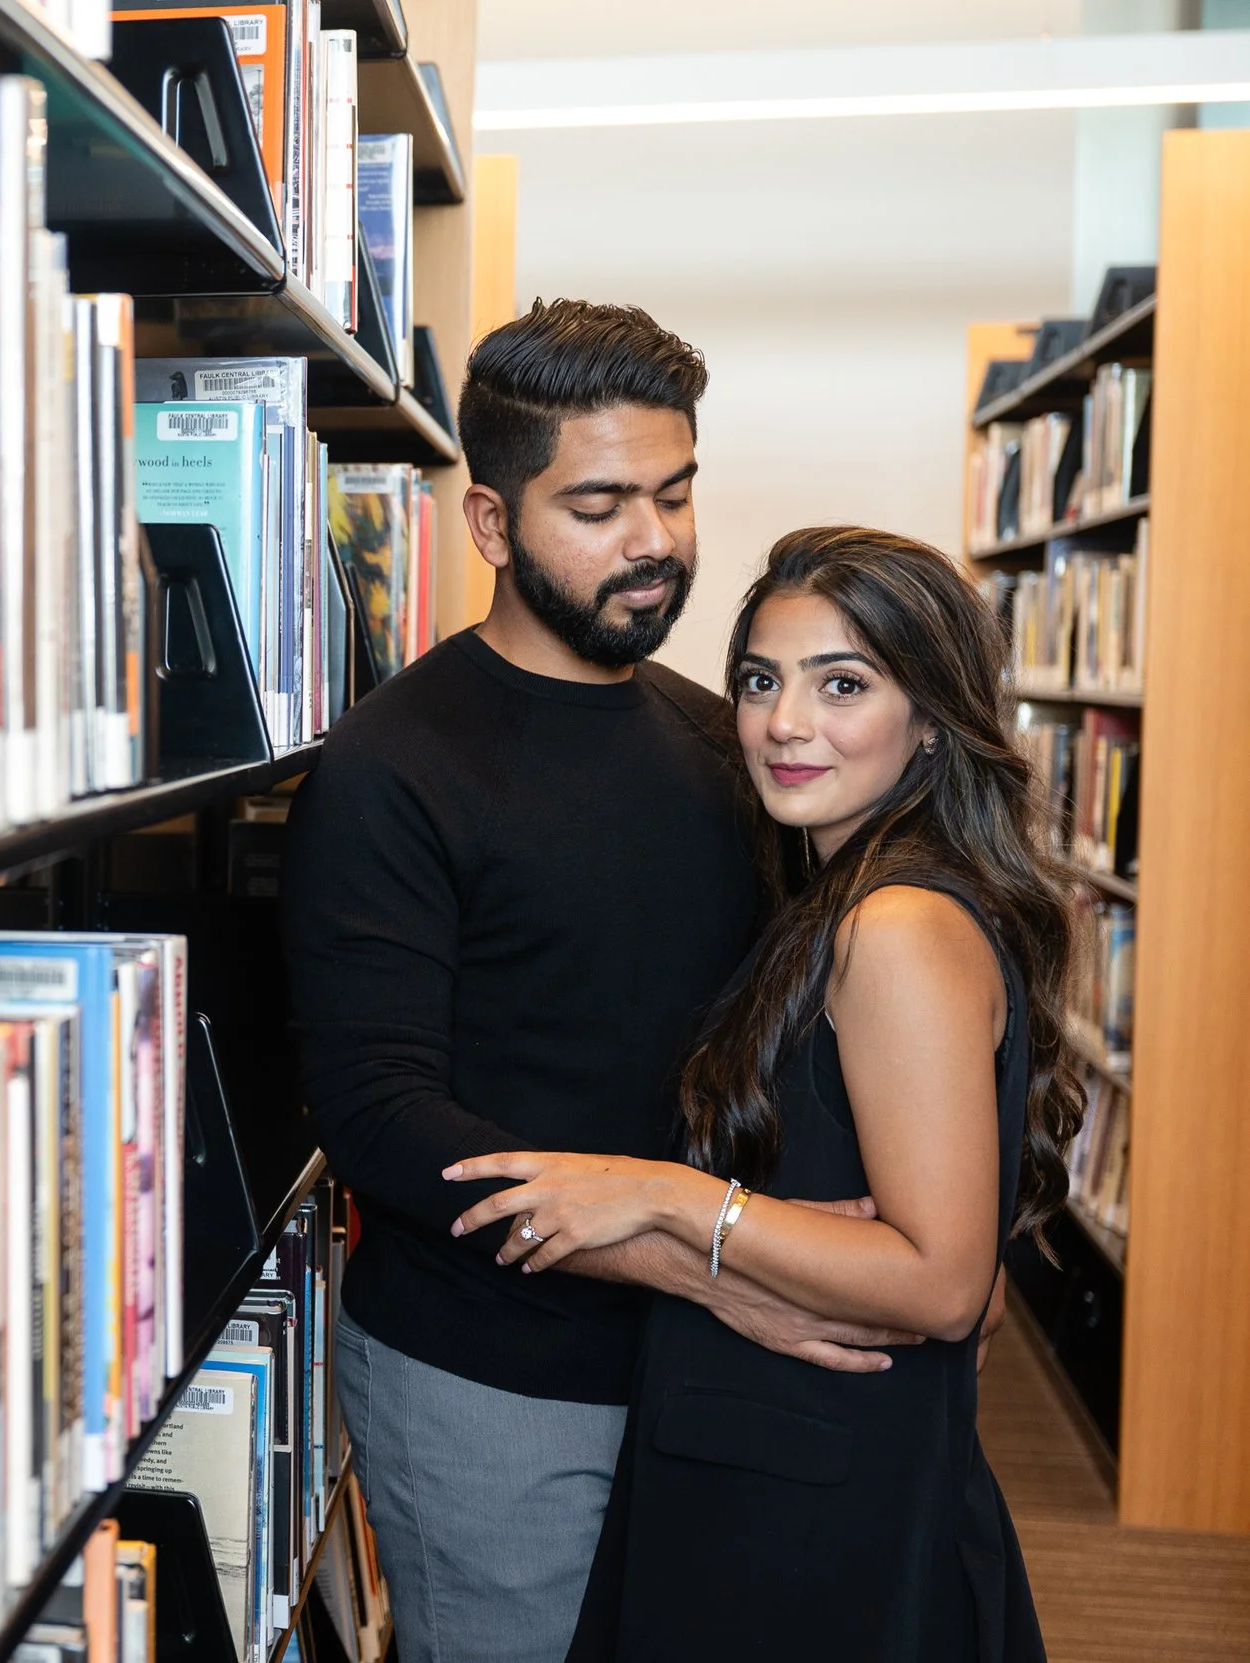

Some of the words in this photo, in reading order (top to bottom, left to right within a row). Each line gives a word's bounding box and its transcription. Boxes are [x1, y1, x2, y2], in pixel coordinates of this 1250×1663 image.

[199, 372, 220, 380] FAULK
[221, 370, 250, 378] CENTRAL
[251, 367, 278, 376] LIBR
[137, 455, 169, 468] wood
[171, 460, 180, 468] in
[181, 455, 213, 468] heels
[136, 1466, 163, 1474] springing
